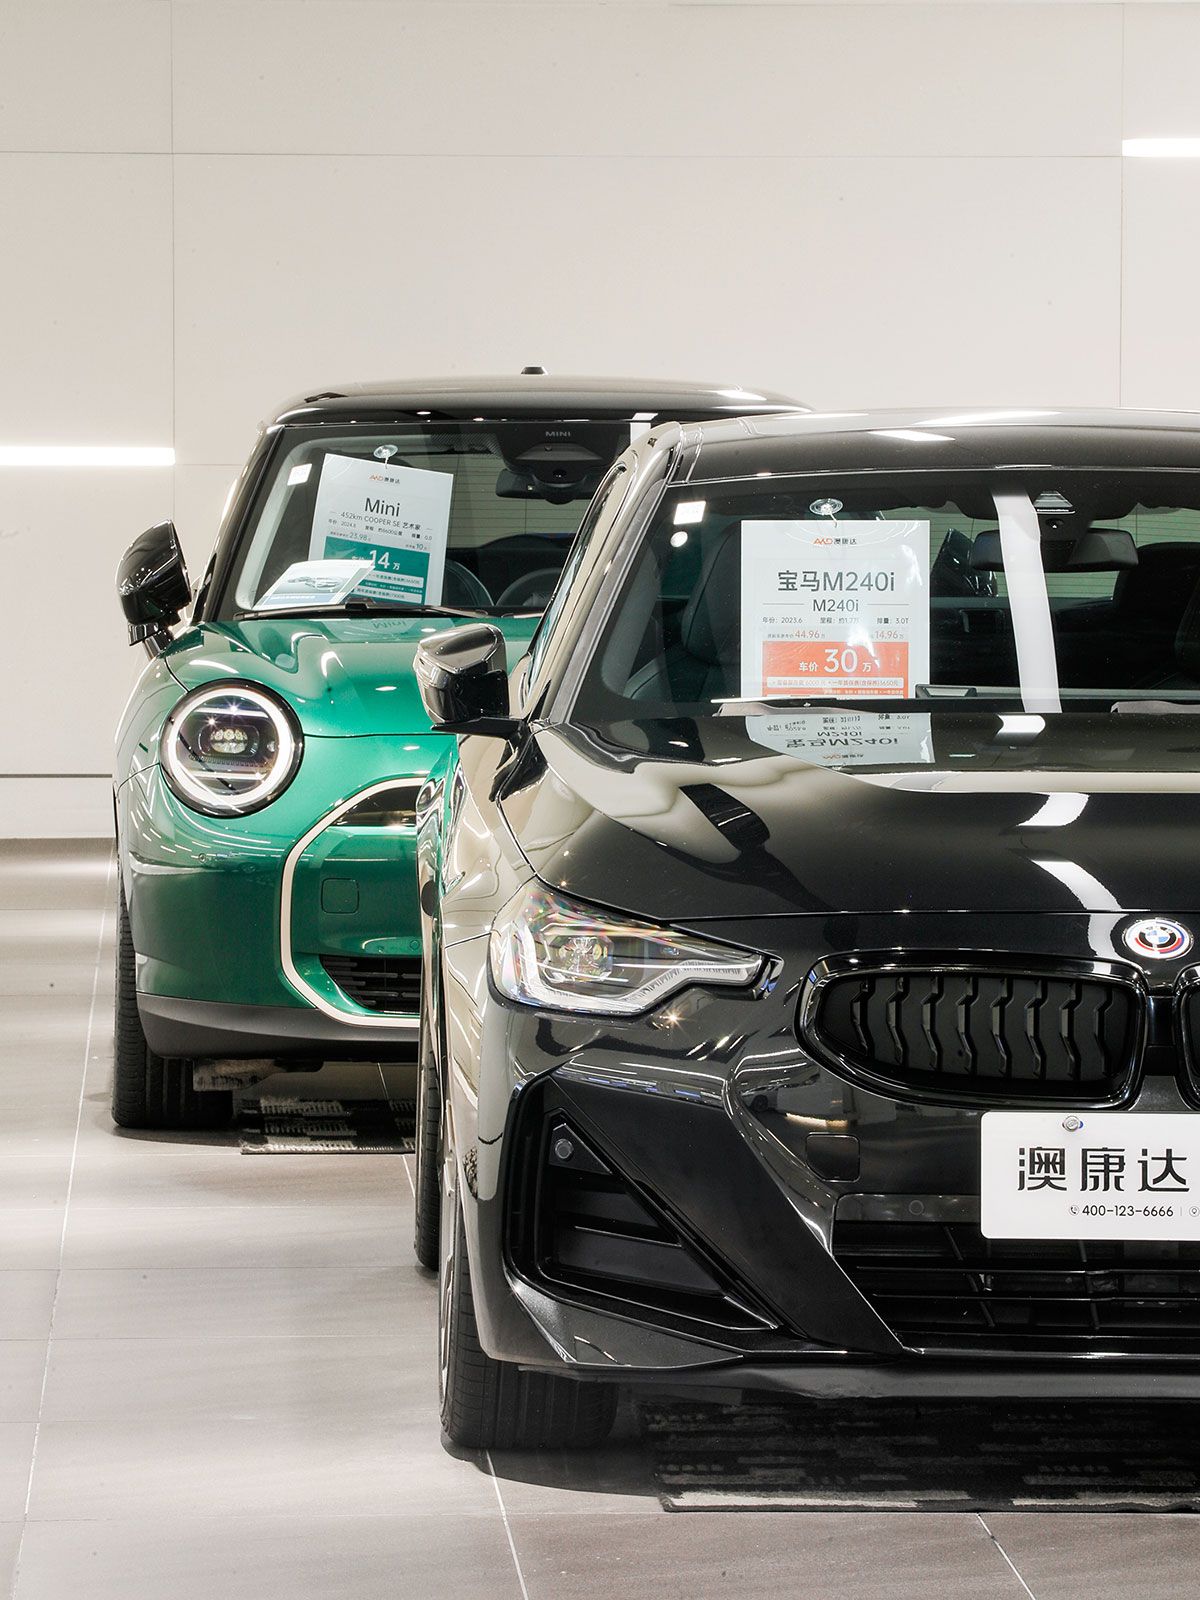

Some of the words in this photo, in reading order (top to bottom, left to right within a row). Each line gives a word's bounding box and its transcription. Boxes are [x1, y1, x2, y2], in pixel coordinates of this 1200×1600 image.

[364, 497, 401, 517] Mini
[340, 511, 363, 522] 452km
[363, 516, 392, 528] COOPER
[393, 519, 401, 528] SE
[369, 549, 390, 569] 14
[393, 561, 401, 571] 万
[777, 569, 895, 592] 宝马M240i
[812, 599, 859, 612] M240i
[794, 629, 820, 639] 44.96
[874, 629, 899, 639] 14.96
[799, 661, 818, 672] 车价
[823, 648, 858, 673] 30
[862, 662, 872, 672] 万
[1017, 1146, 1190, 1192] 澳康达
[1082, 1205, 1174, 1217] 400-123-6666
